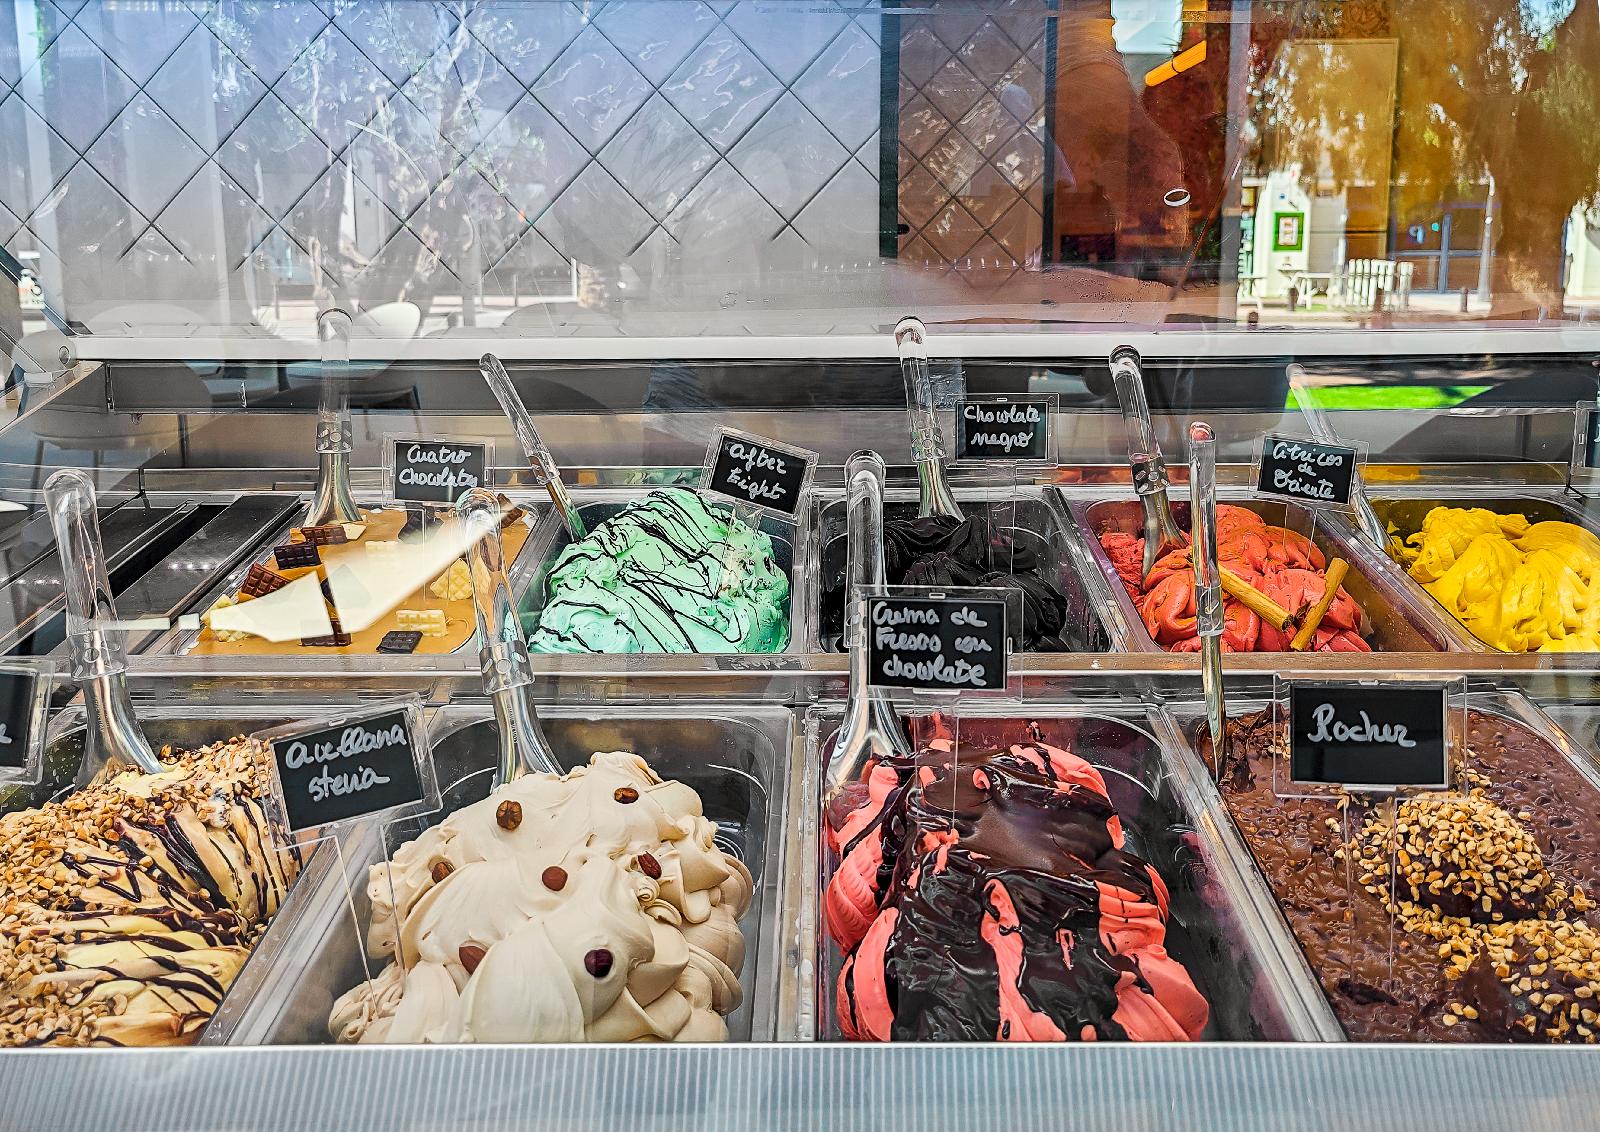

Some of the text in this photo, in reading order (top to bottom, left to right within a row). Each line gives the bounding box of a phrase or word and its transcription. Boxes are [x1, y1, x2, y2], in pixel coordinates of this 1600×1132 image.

[970, 431, 1034, 453] negro
[407, 444, 472, 464] Cuatro
[1297, 462, 1317, 477] de
[950, 605, 988, 627] de
[1307, 703, 1417, 748] Rocher
[308, 764, 391, 802] stevia
